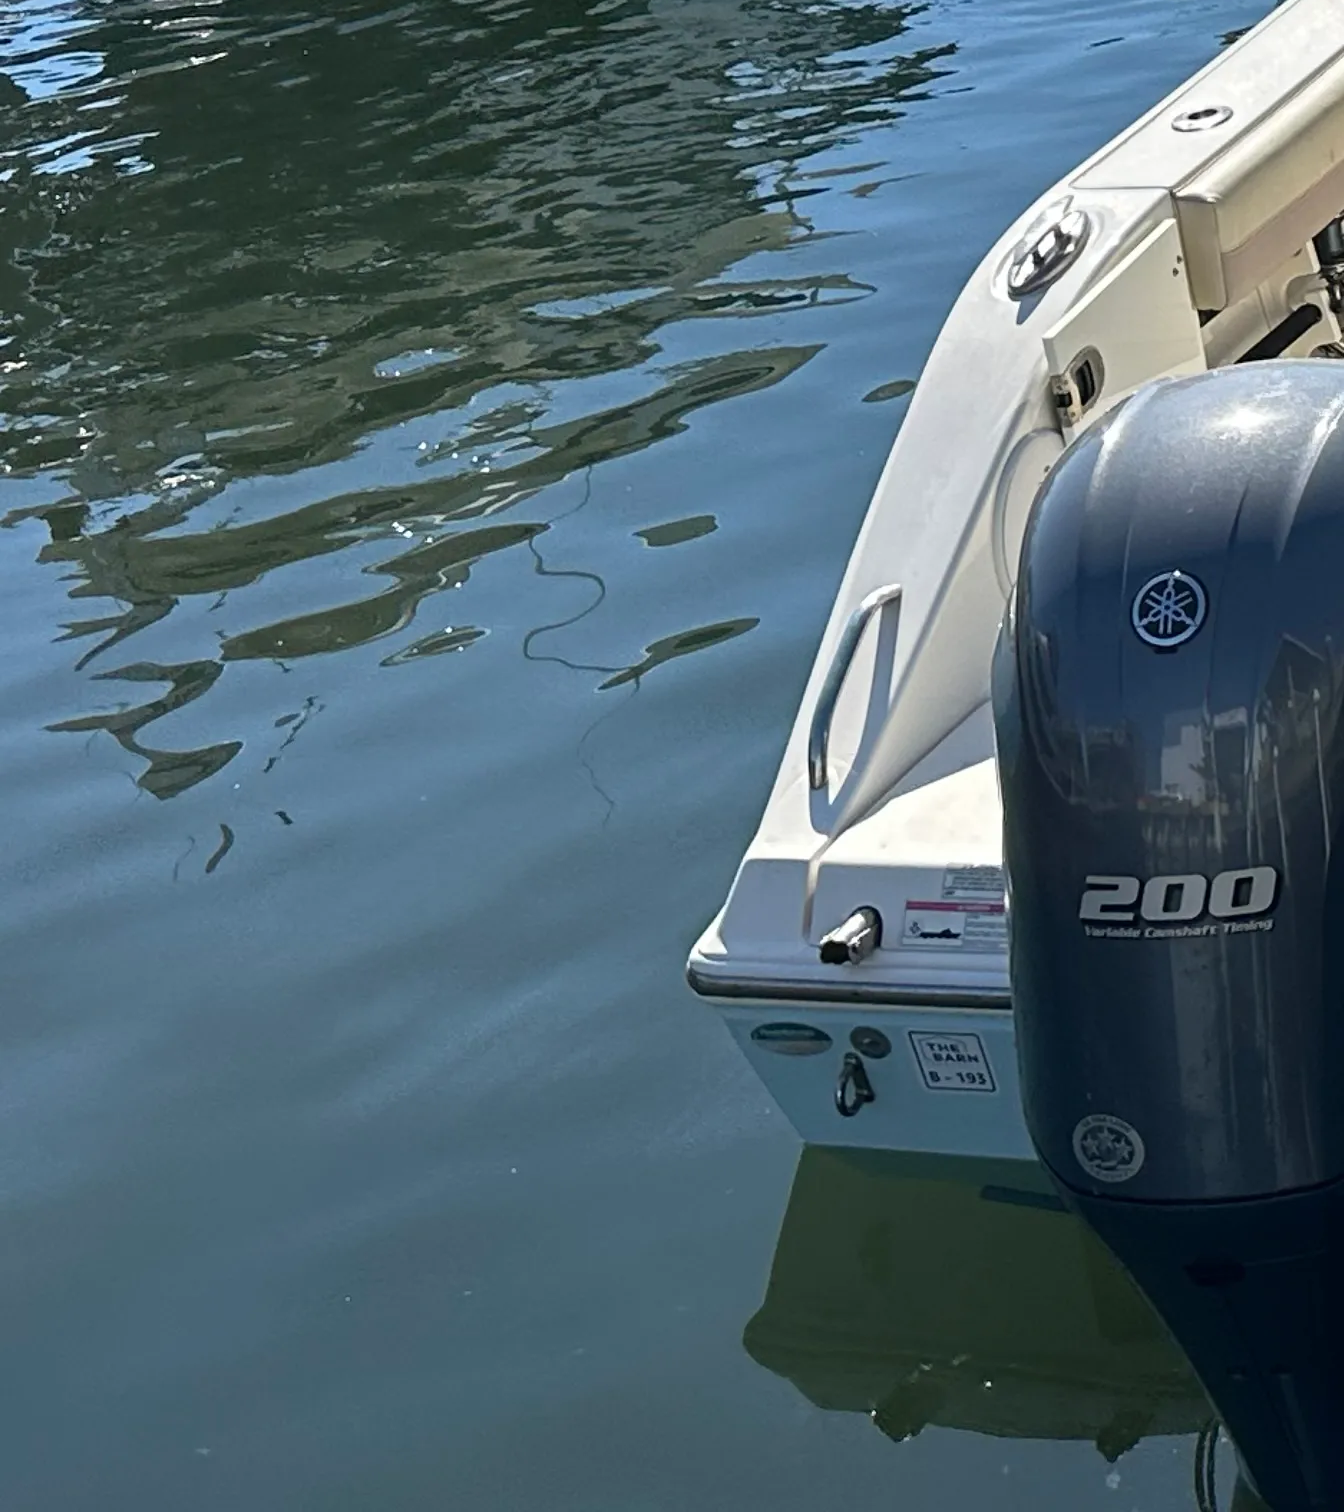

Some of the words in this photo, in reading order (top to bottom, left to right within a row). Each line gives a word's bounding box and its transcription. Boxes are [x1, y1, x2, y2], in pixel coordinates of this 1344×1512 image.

[1079, 865, 1278, 922] 200
[1084, 924, 1141, 938] Variable
[1144, 923, 1217, 938] Camshaft
[1223, 918, 1275, 936] Timing
[927, 1042, 961, 1054] THE
[933, 1052, 981, 1064] BARN
[956, 1071, 988, 1086] 193
